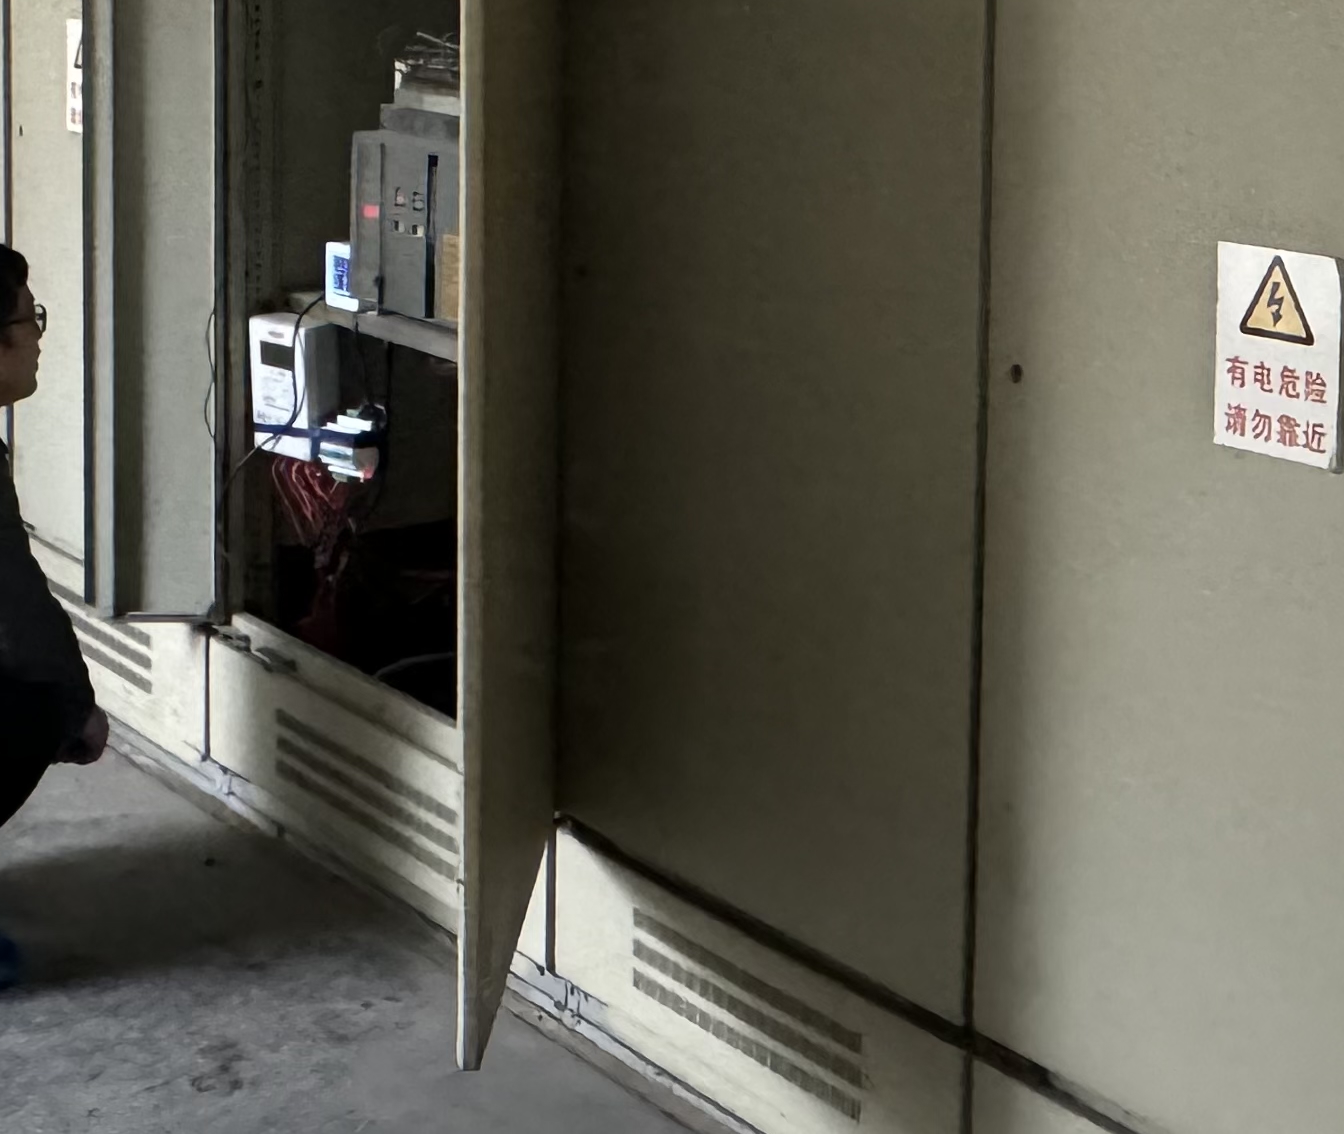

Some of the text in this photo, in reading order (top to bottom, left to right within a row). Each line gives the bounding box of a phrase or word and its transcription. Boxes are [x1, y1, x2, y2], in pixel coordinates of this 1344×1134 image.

[1225, 355, 1328, 404] 有电危险
[1224, 403, 1327, 454] 请勿靠近
